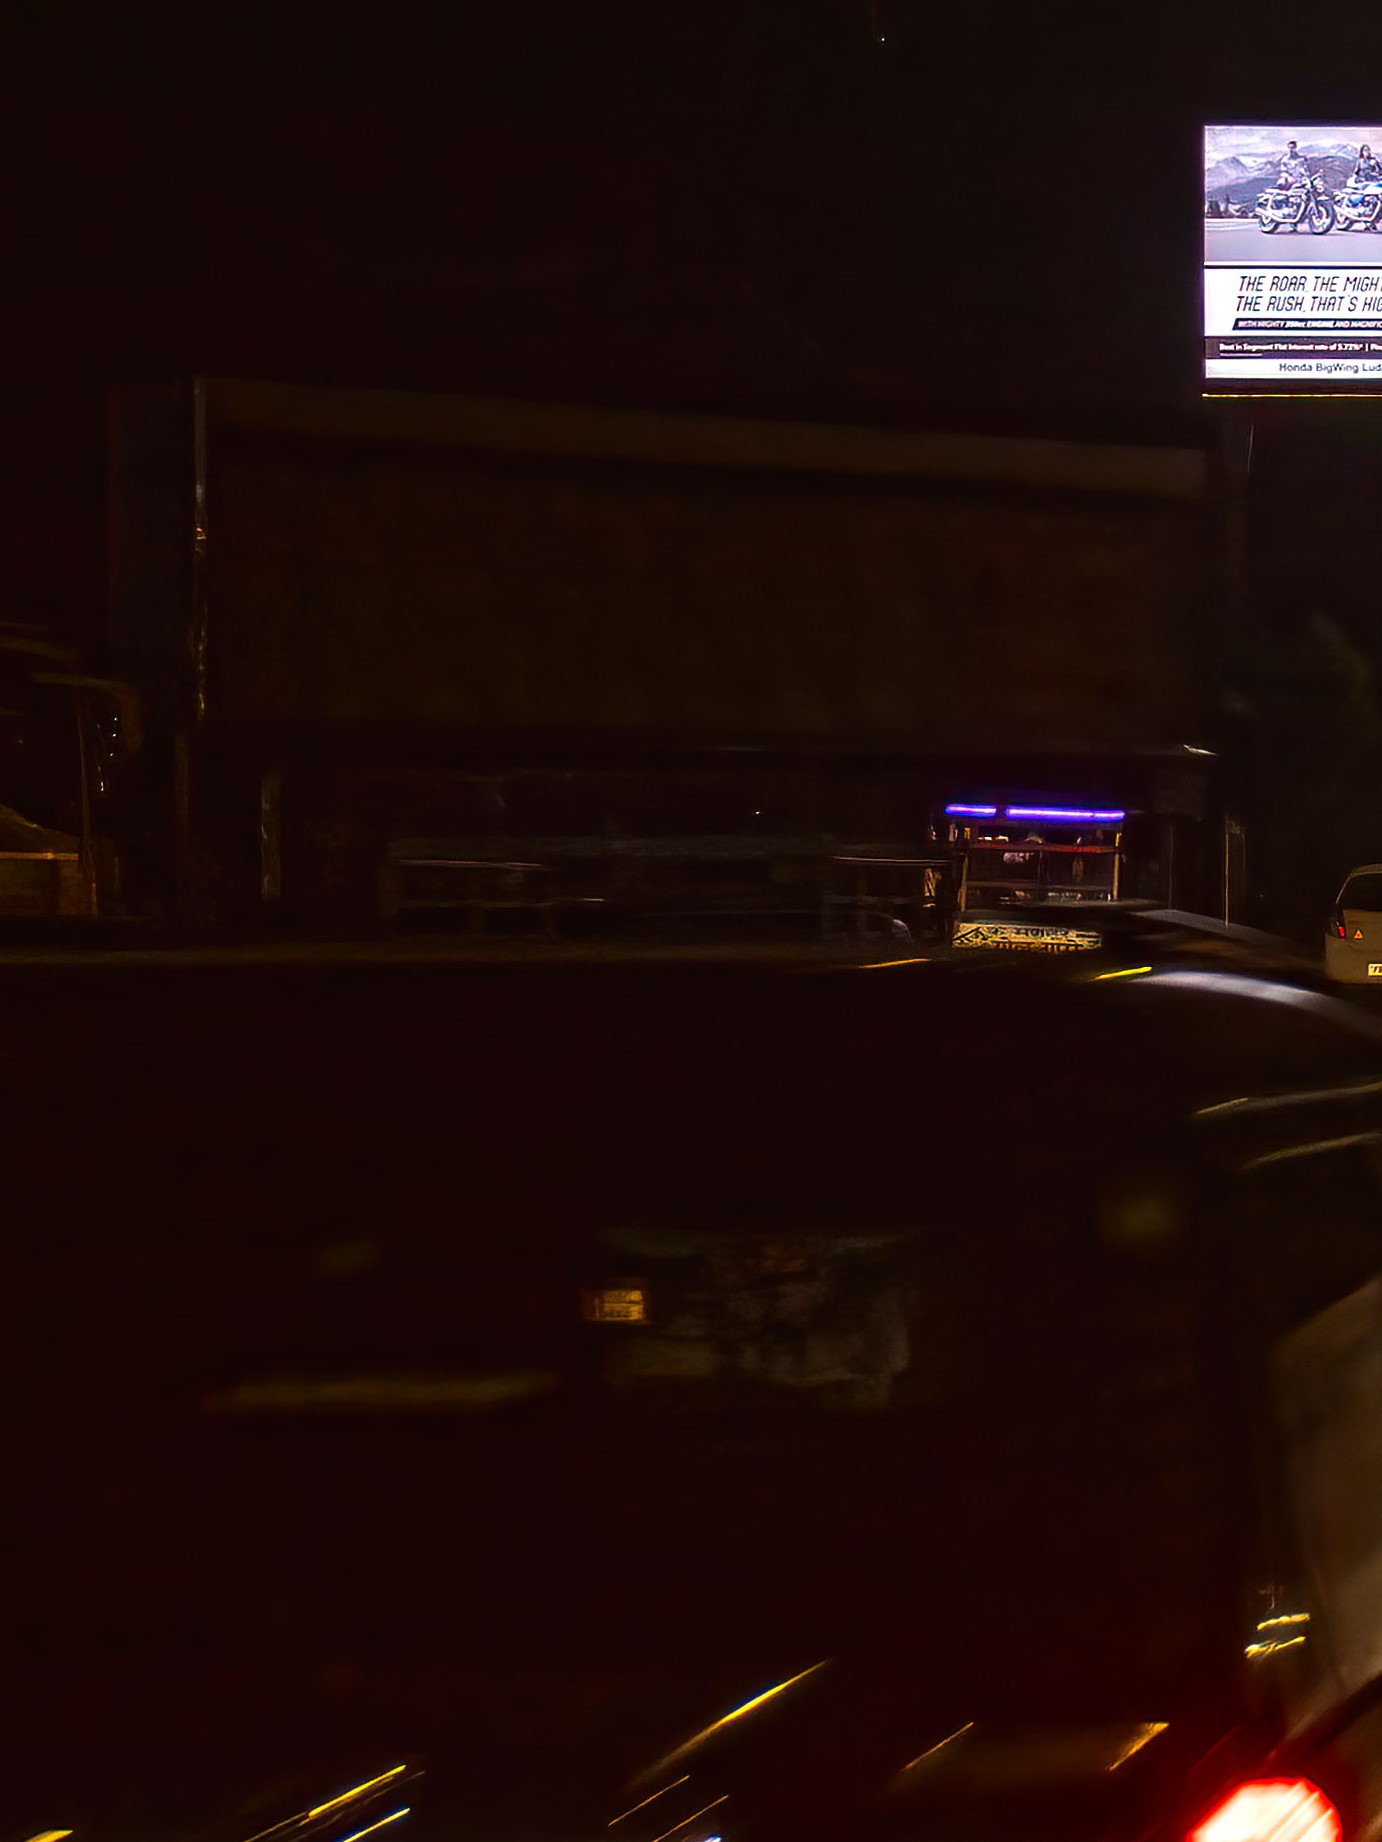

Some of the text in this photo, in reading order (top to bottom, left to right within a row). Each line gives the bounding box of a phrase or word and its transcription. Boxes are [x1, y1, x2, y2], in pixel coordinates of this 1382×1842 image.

[1239, 276, 1266, 292] THE
[1313, 276, 1340, 292] THE
[1236, 296, 1263, 312] THE
[1310, 294, 1358, 312] THAT'S
[1279, 363, 1312, 372] Honda
[1315, 363, 1359, 374] BigWing
